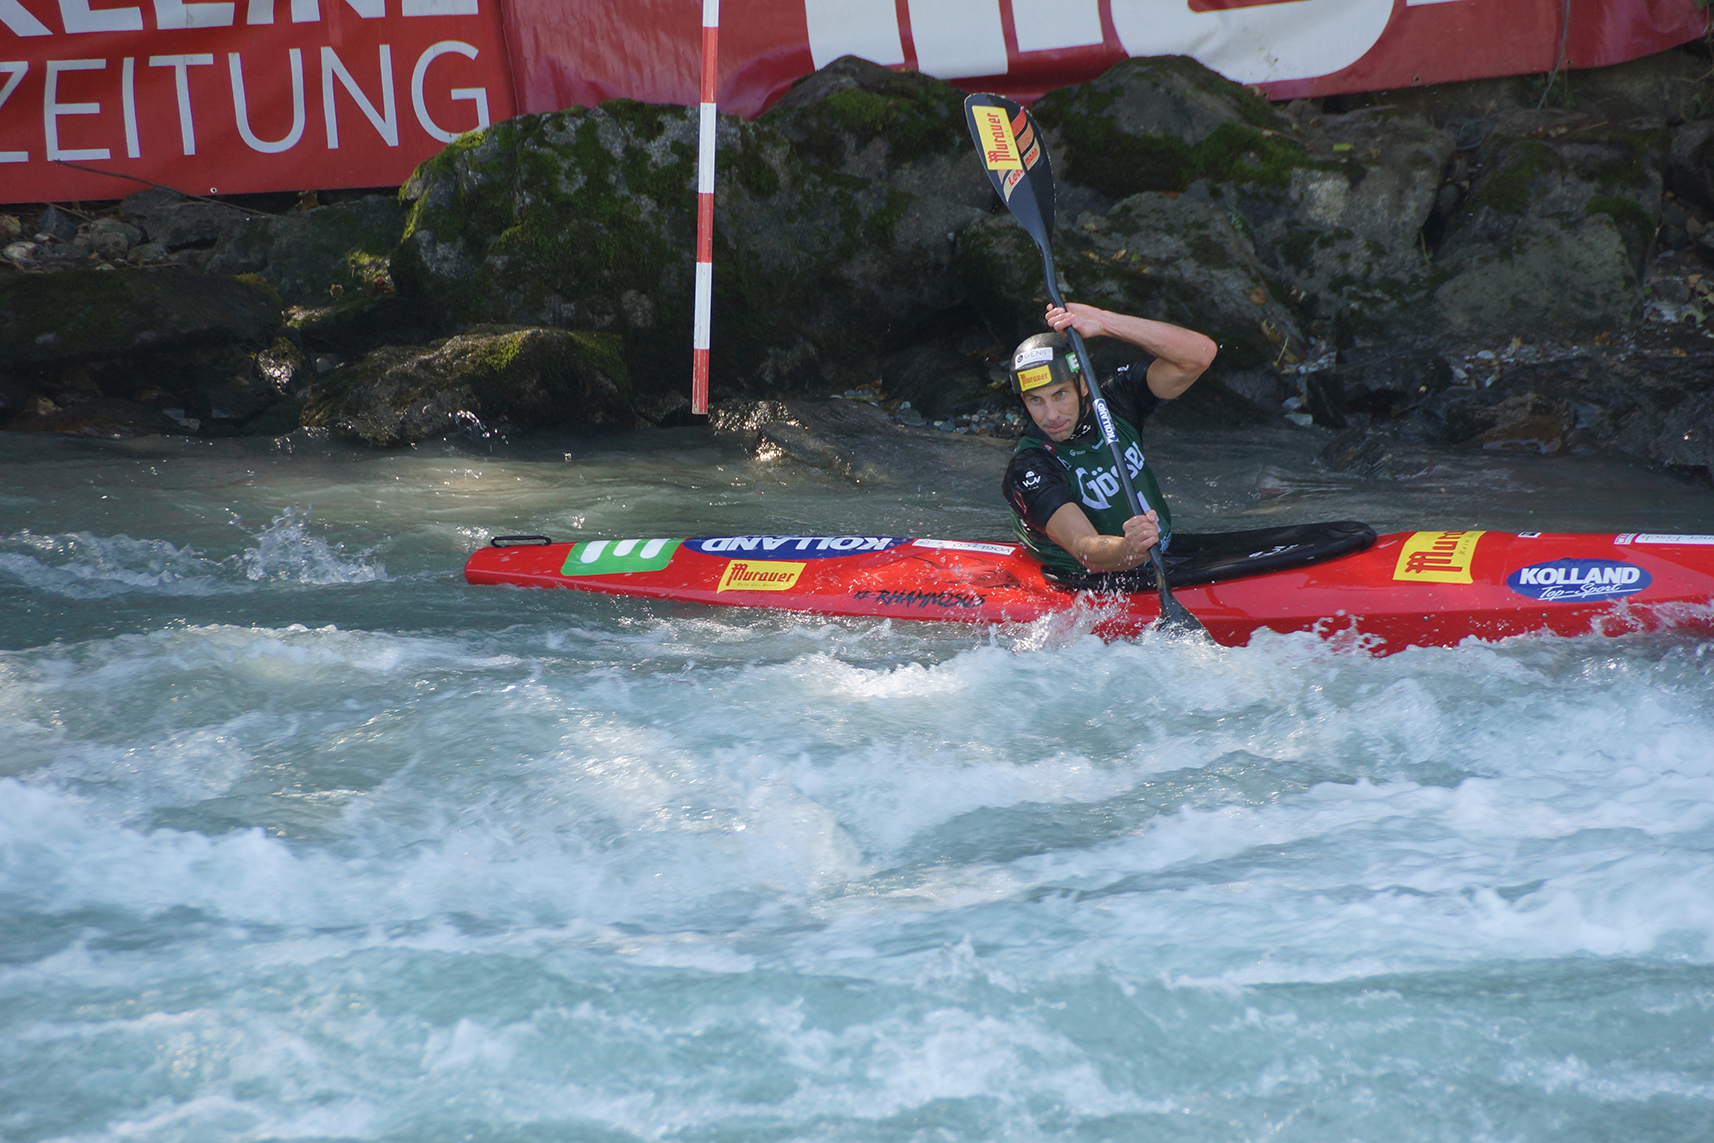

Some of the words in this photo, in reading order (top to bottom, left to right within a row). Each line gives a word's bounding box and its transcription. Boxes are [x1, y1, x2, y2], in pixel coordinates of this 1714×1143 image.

[987, 112, 1018, 163] Murauer
[1097, 402, 1115, 439] KOLLAND
[701, 536, 893, 551] KOLLAND
[725, 563, 795, 587] Murauer
[1519, 567, 1641, 584] KOLLAND
[1539, 582, 1623, 600] Top-Sport
